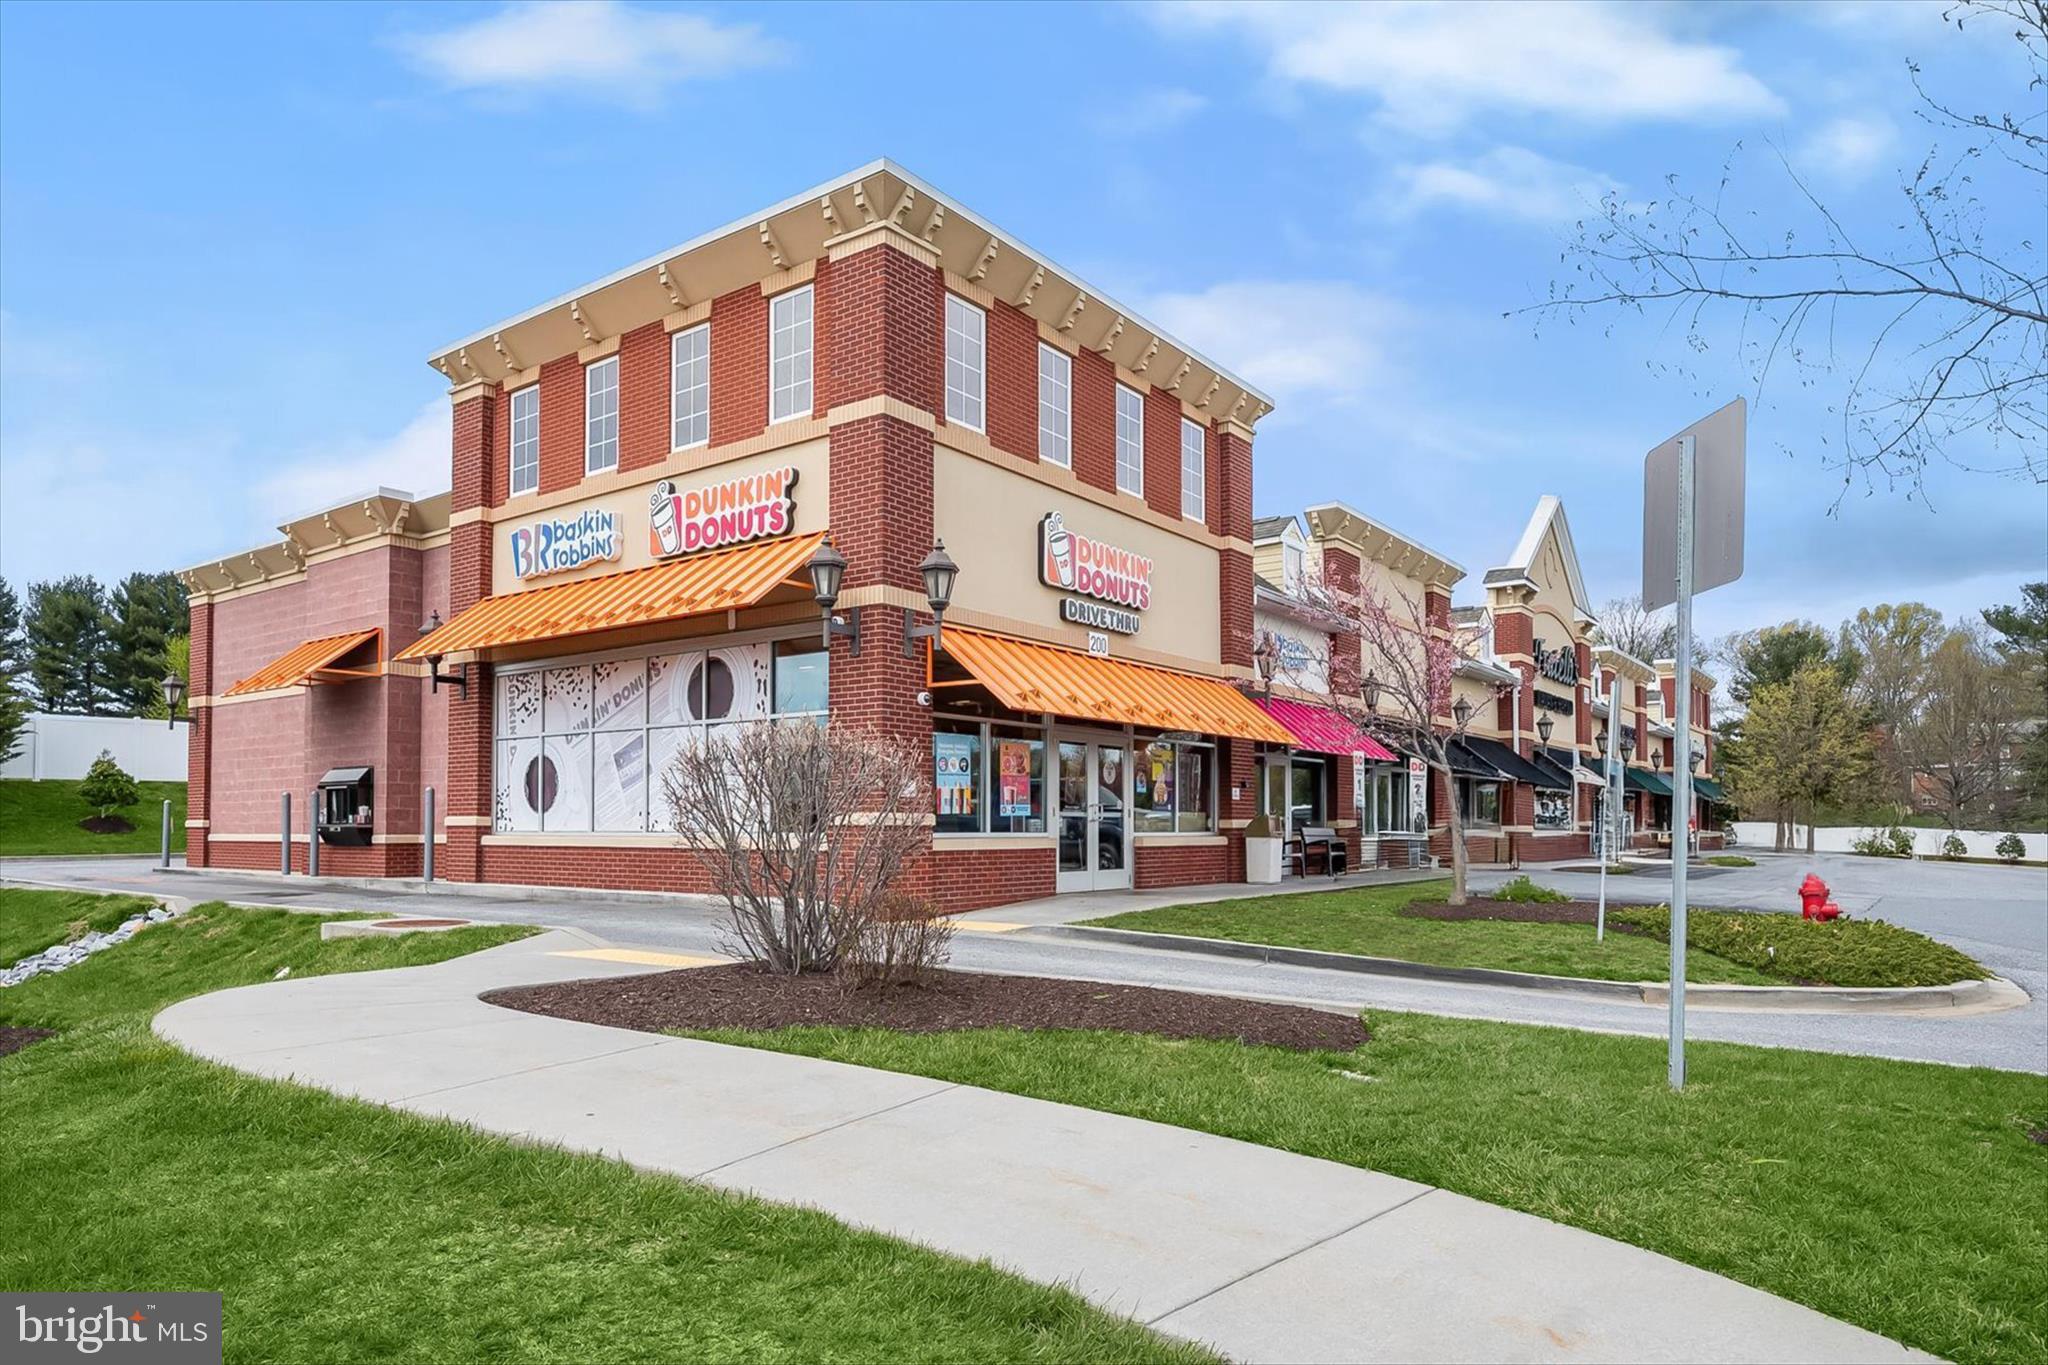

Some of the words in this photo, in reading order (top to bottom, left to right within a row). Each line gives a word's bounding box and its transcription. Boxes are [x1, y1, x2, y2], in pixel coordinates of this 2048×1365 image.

[685, 468, 790, 519] DUNKIN'
[685, 501, 784, 549] DONUTS
[511, 523, 553, 577] BR
[553, 534, 613, 569] robbins
[1077, 537, 1152, 582] DUNKIN'
[1078, 565, 1149, 609] DONUTS
[1090, 635, 1106, 654] 200
